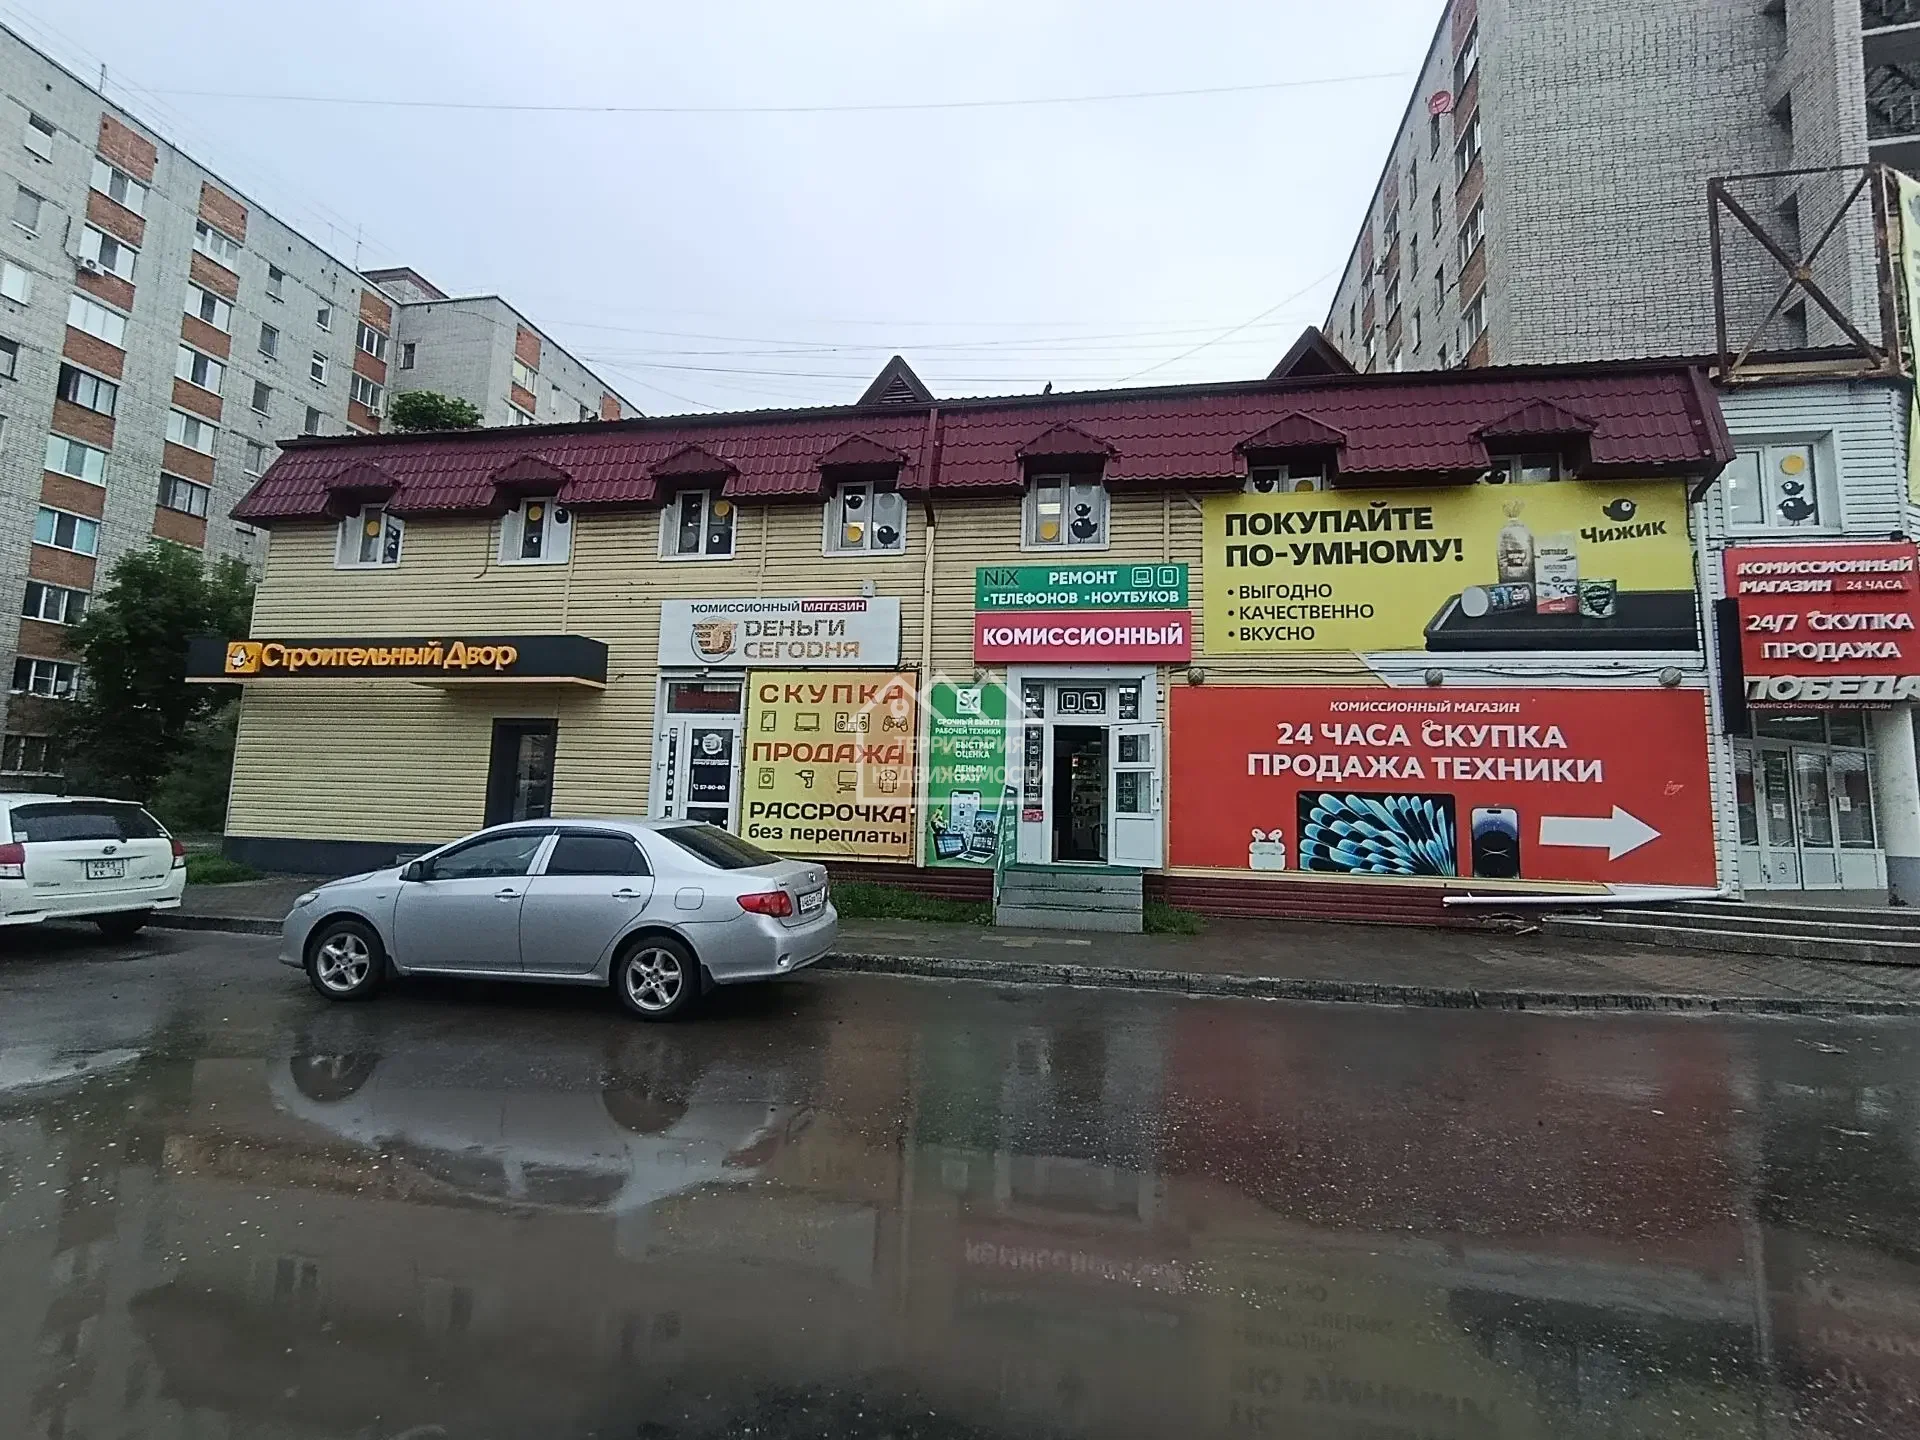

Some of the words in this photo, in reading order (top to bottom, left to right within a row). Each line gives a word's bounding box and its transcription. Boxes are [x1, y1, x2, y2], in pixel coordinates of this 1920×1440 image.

[1225, 500, 1434, 537] ПОКУПАЙТЕ
[1580, 520, 1667, 543] Чижик
[1226, 538, 1464, 567] ПО-УМНОМУ!
[1736, 556, 1913, 576] КОМИССИОННЫЙ
[1048, 570, 1118, 585] РЕМОНТ
[1739, 580, 1832, 594] МАГАЗИН
[1846, 580, 1863, 590] 24
[1865, 579, 1904, 590] ЧАСА
[990, 591, 1079, 605] ТЕЛЕФОНОВ
[1090, 590, 1180, 604] НОУТБУКОВ
[1239, 584, 1332, 599] ВЫГОДНО
[691, 600, 800, 614] КОМИССИОННЫЙ
[803, 600, 866, 612] МАГАЗИН
[1239, 603, 1374, 620] КАЧЕСТВЕННО
[1746, 614, 1798, 633] 24/7
[1808, 612, 1915, 631] СКУПКА
[983, 622, 1184, 646] КОМИССИОННЫЙ
[1239, 625, 1316, 641] ВКУСНО
[262, 640, 443, 671] Строительный
[443, 640, 518, 671] Двор
[744, 641, 860, 659] СЕГОДНЯ
[1761, 640, 1902, 663] ПРОДАЖА
[759, 684, 904, 704] СКУПКА
[1744, 675, 1920, 701] ПОБЕДА
[1330, 700, 1451, 713] КОМИССИОННЫЙ
[1454, 702, 1520, 713] МАГАЗИН
[1838, 701, 1892, 710] МАГАЗИН
[935, 726, 968, 735] РАБОЧЕЙ
[969, 727, 1001, 735] ТЕХНИКИ
[937, 717, 974, 726] СРОЧНЫЙ
[1277, 722, 1313, 745] 24
[1320, 723, 1412, 747] ЧАСА
[1421, 721, 1568, 749] СКУПКА
[752, 743, 905, 765] ПРОДАЖА
[955, 741, 995, 750] БЫСТРАЯ
[955, 750, 990, 759] ОЦЕНКА
[1247, 753, 1425, 783] ПРОДАЖА
[1431, 757, 1603, 783] ТЕХНИКИ
[954, 773, 982, 783] СРАЗУ
[750, 801, 906, 823] РАССРОЧКА
[748, 823, 783, 840] без
[790, 826, 907, 845] переплаты
